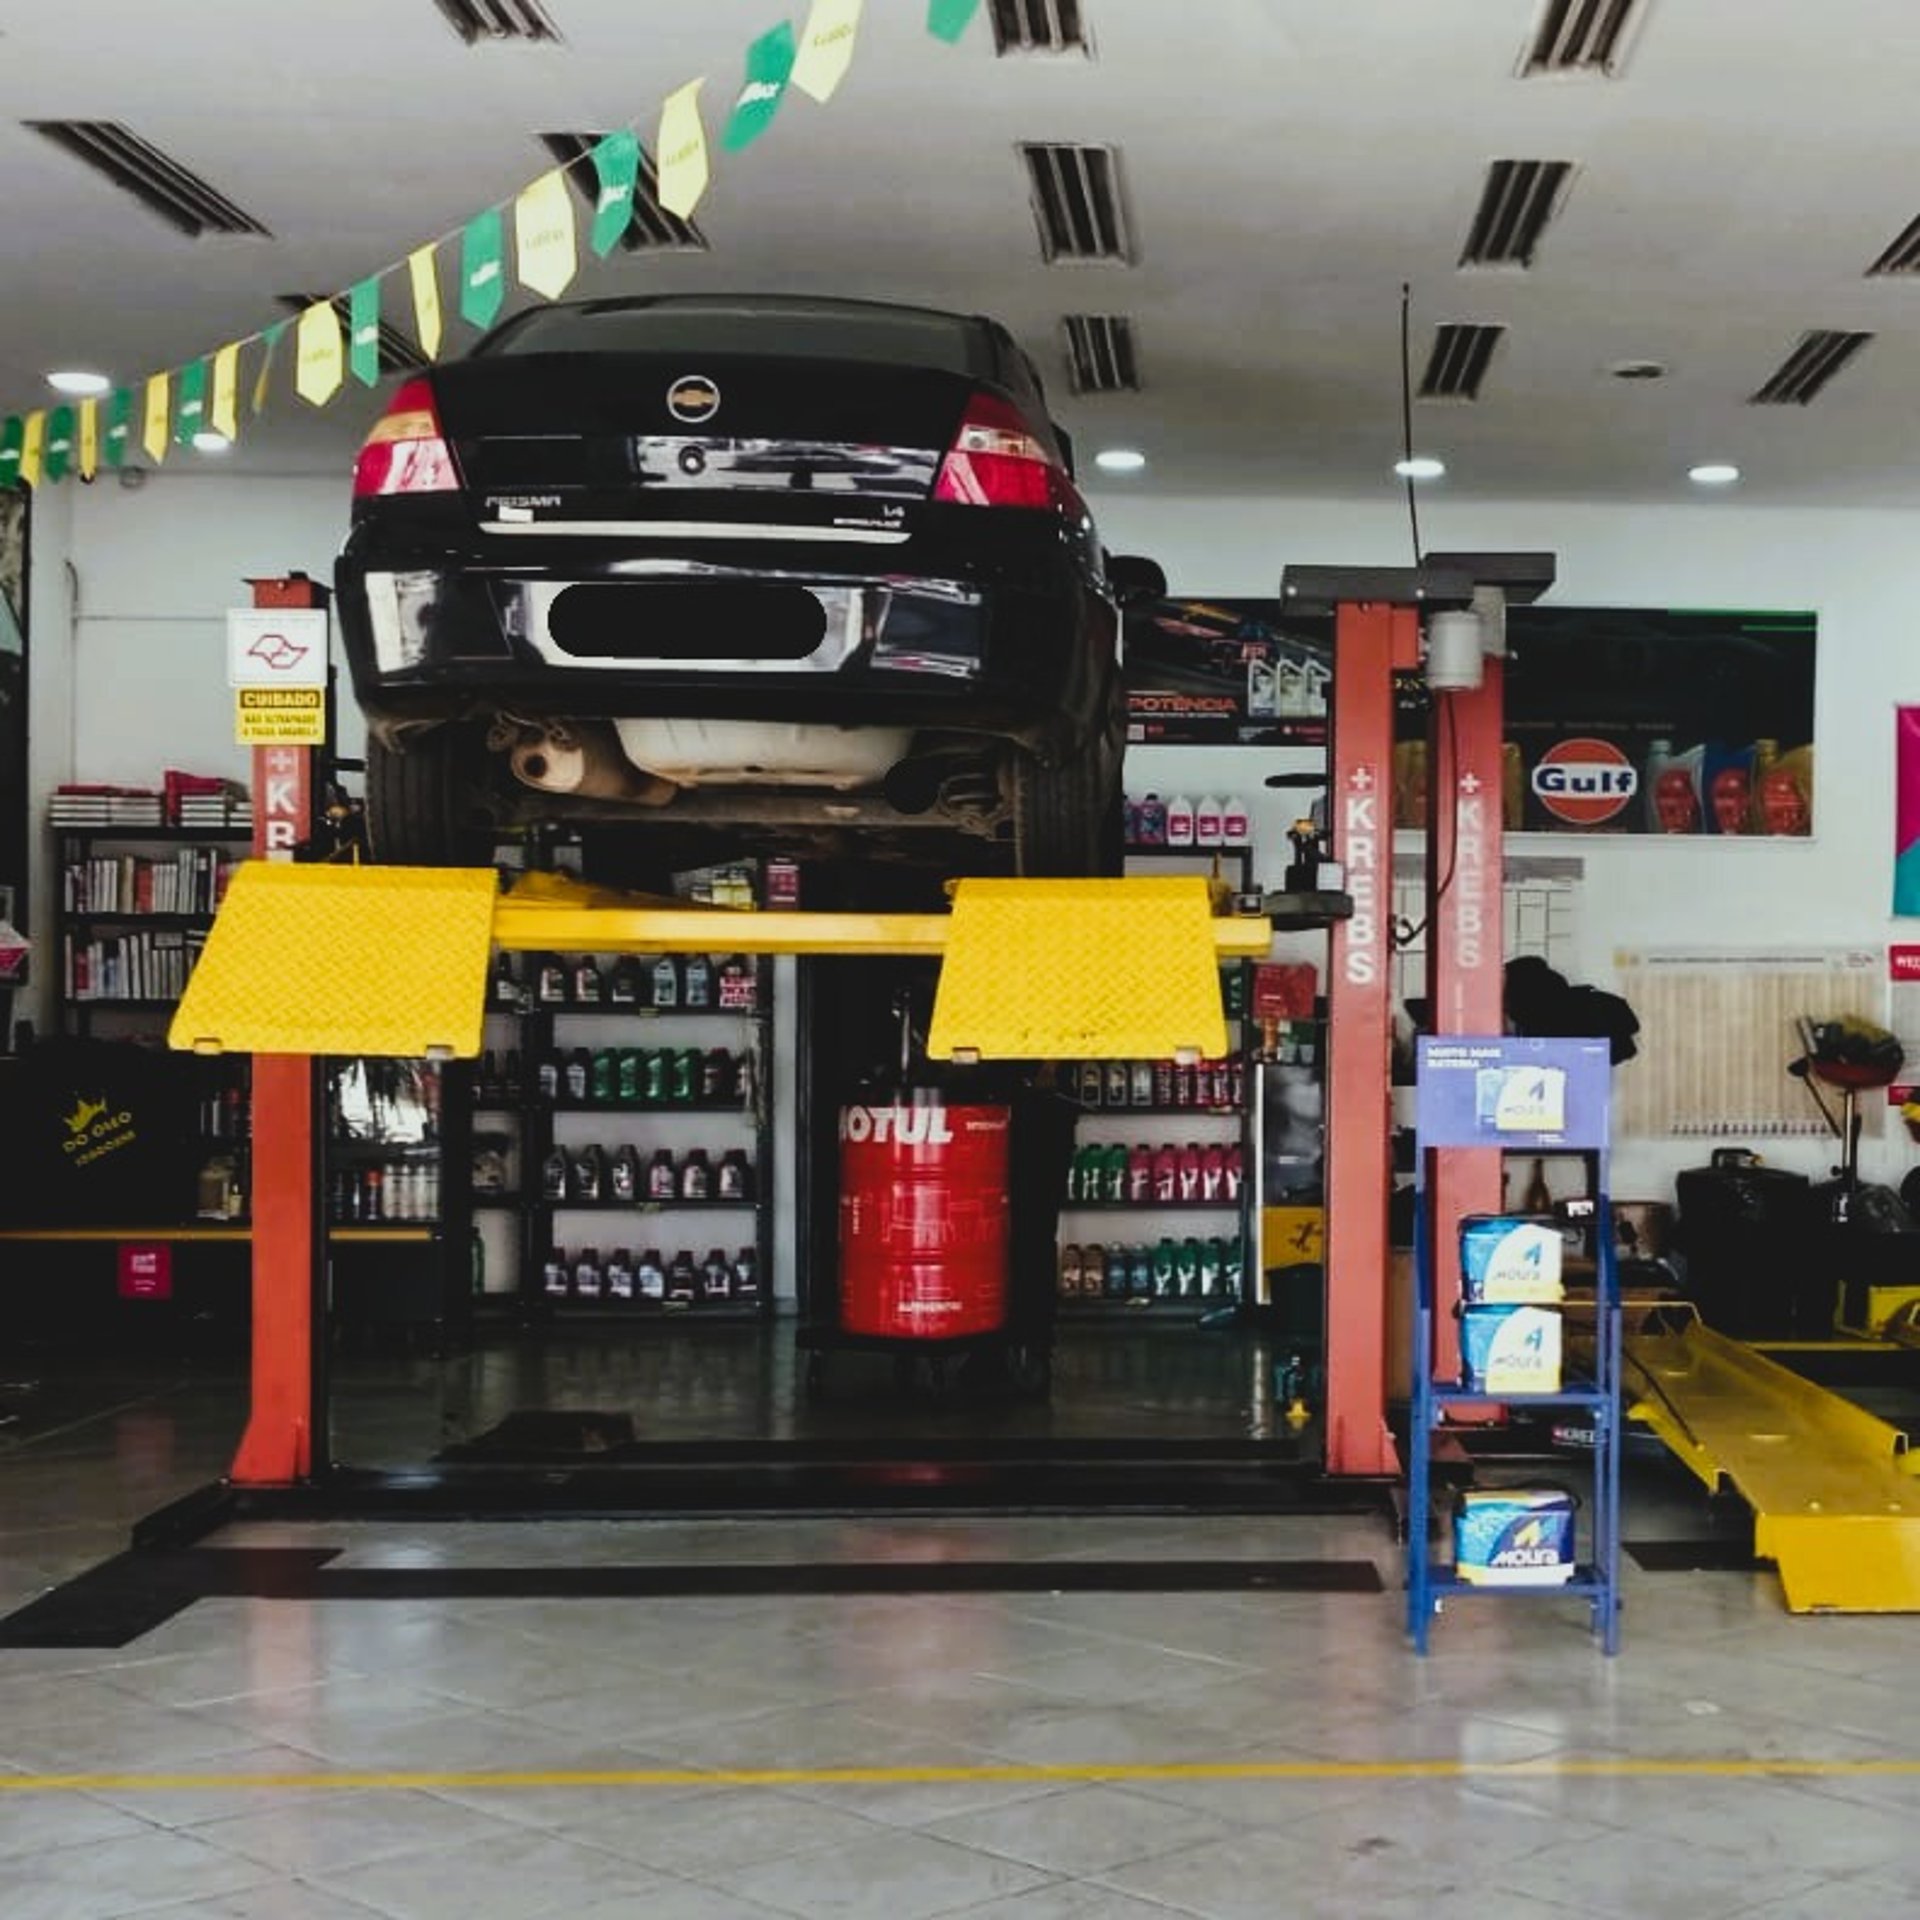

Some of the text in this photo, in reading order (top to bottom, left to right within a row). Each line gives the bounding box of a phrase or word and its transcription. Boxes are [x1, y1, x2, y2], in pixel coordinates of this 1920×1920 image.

[243, 692, 317, 707] CUIDADO
[1536, 767, 1633, 793] Gulf
[1346, 797, 1376, 985] KREBS
[1457, 799, 1483, 969] KREBS
